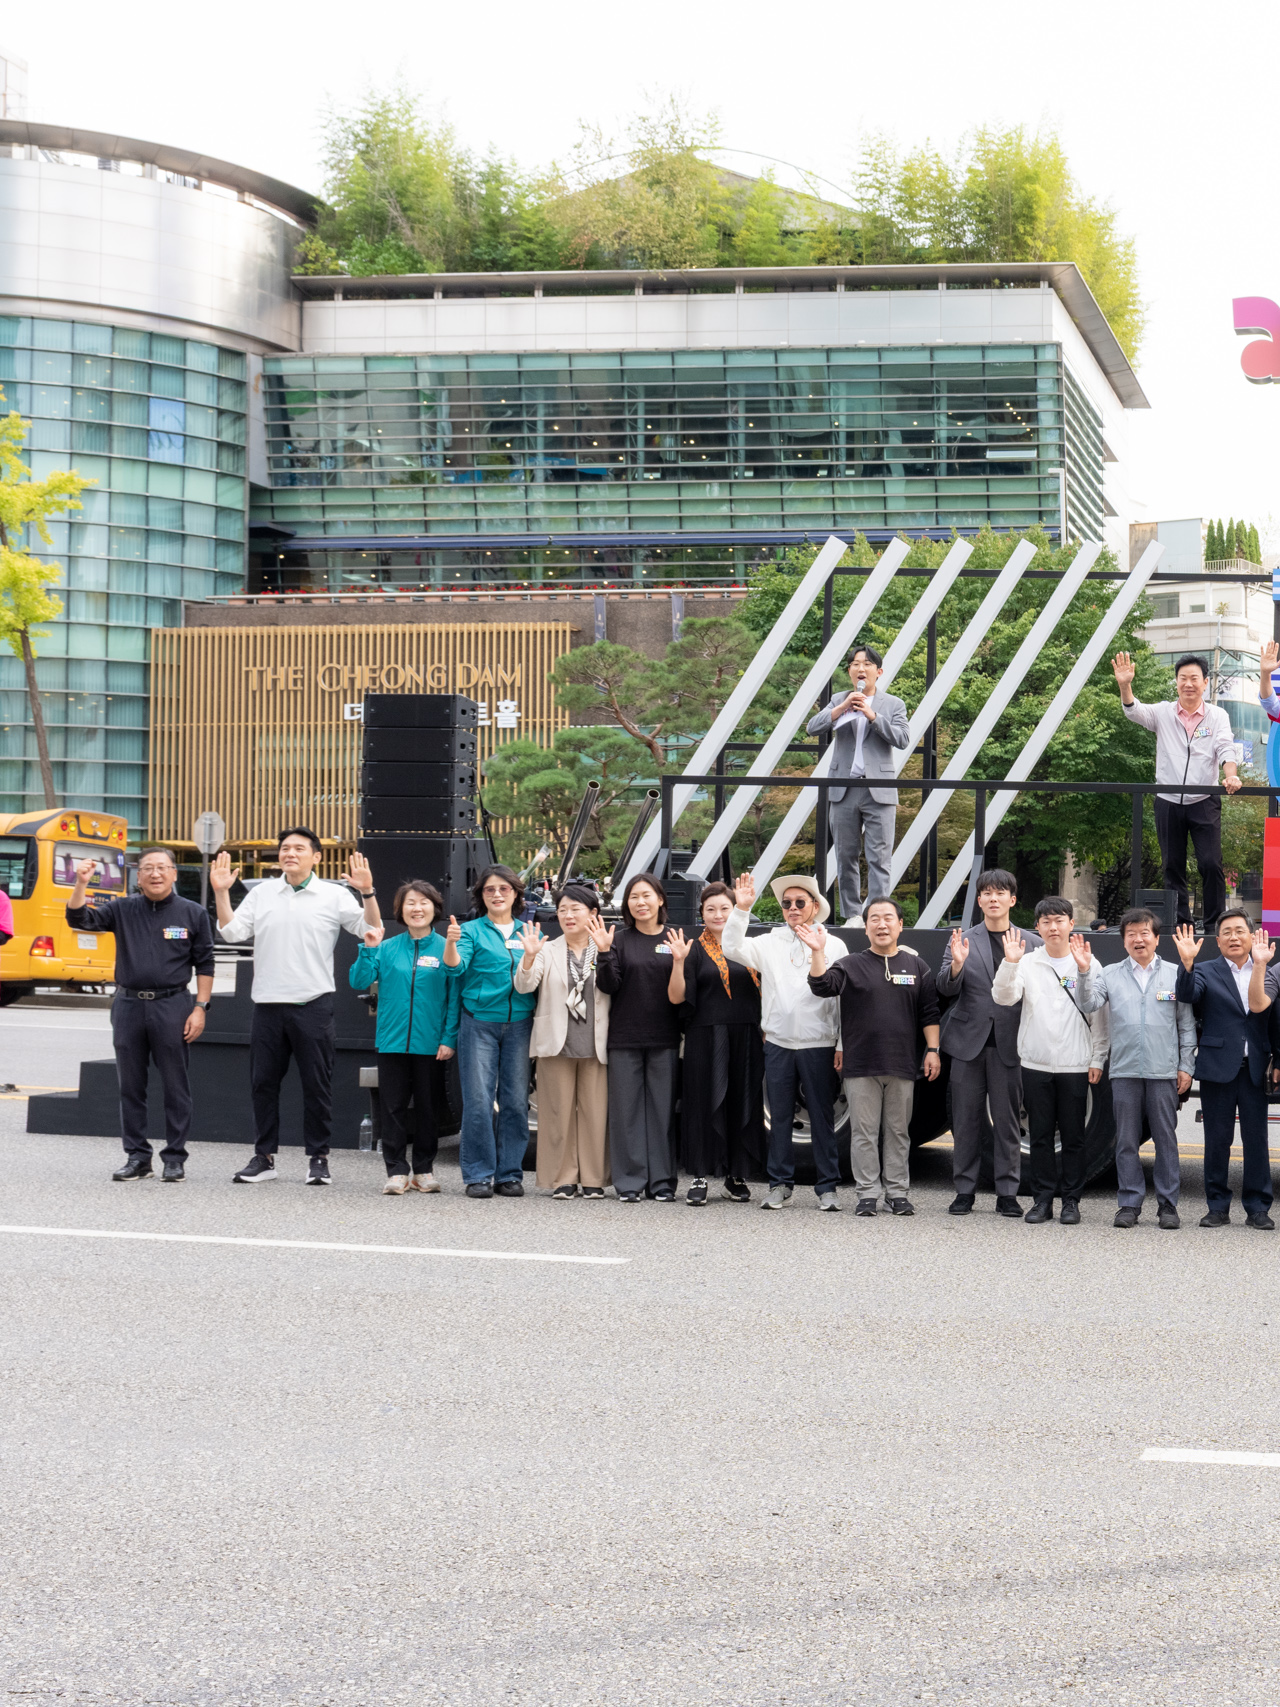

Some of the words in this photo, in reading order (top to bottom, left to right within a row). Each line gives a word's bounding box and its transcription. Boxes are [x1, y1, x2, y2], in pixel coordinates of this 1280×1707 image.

[243, 666, 304, 691] THE
[317, 663, 447, 692] CHEONG
[458, 663, 521, 688] DAM
